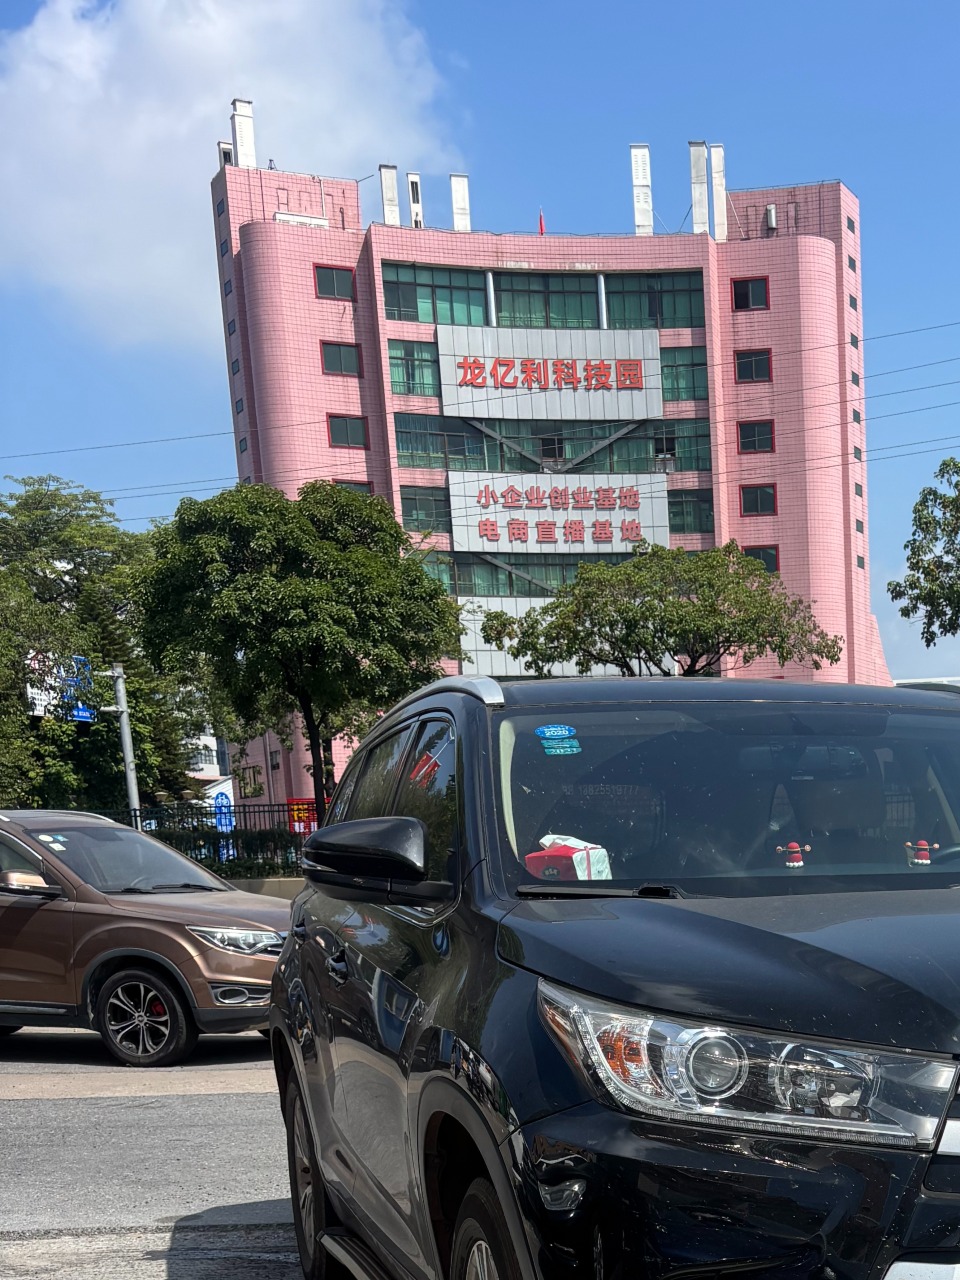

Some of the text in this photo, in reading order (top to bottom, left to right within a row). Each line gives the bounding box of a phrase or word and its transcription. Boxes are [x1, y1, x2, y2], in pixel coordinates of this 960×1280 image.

[457, 356, 644, 390] 龙亿利科技园
[476, 484, 641, 510] 小企业创业基地
[478, 518, 642, 543] 电商直播基地
